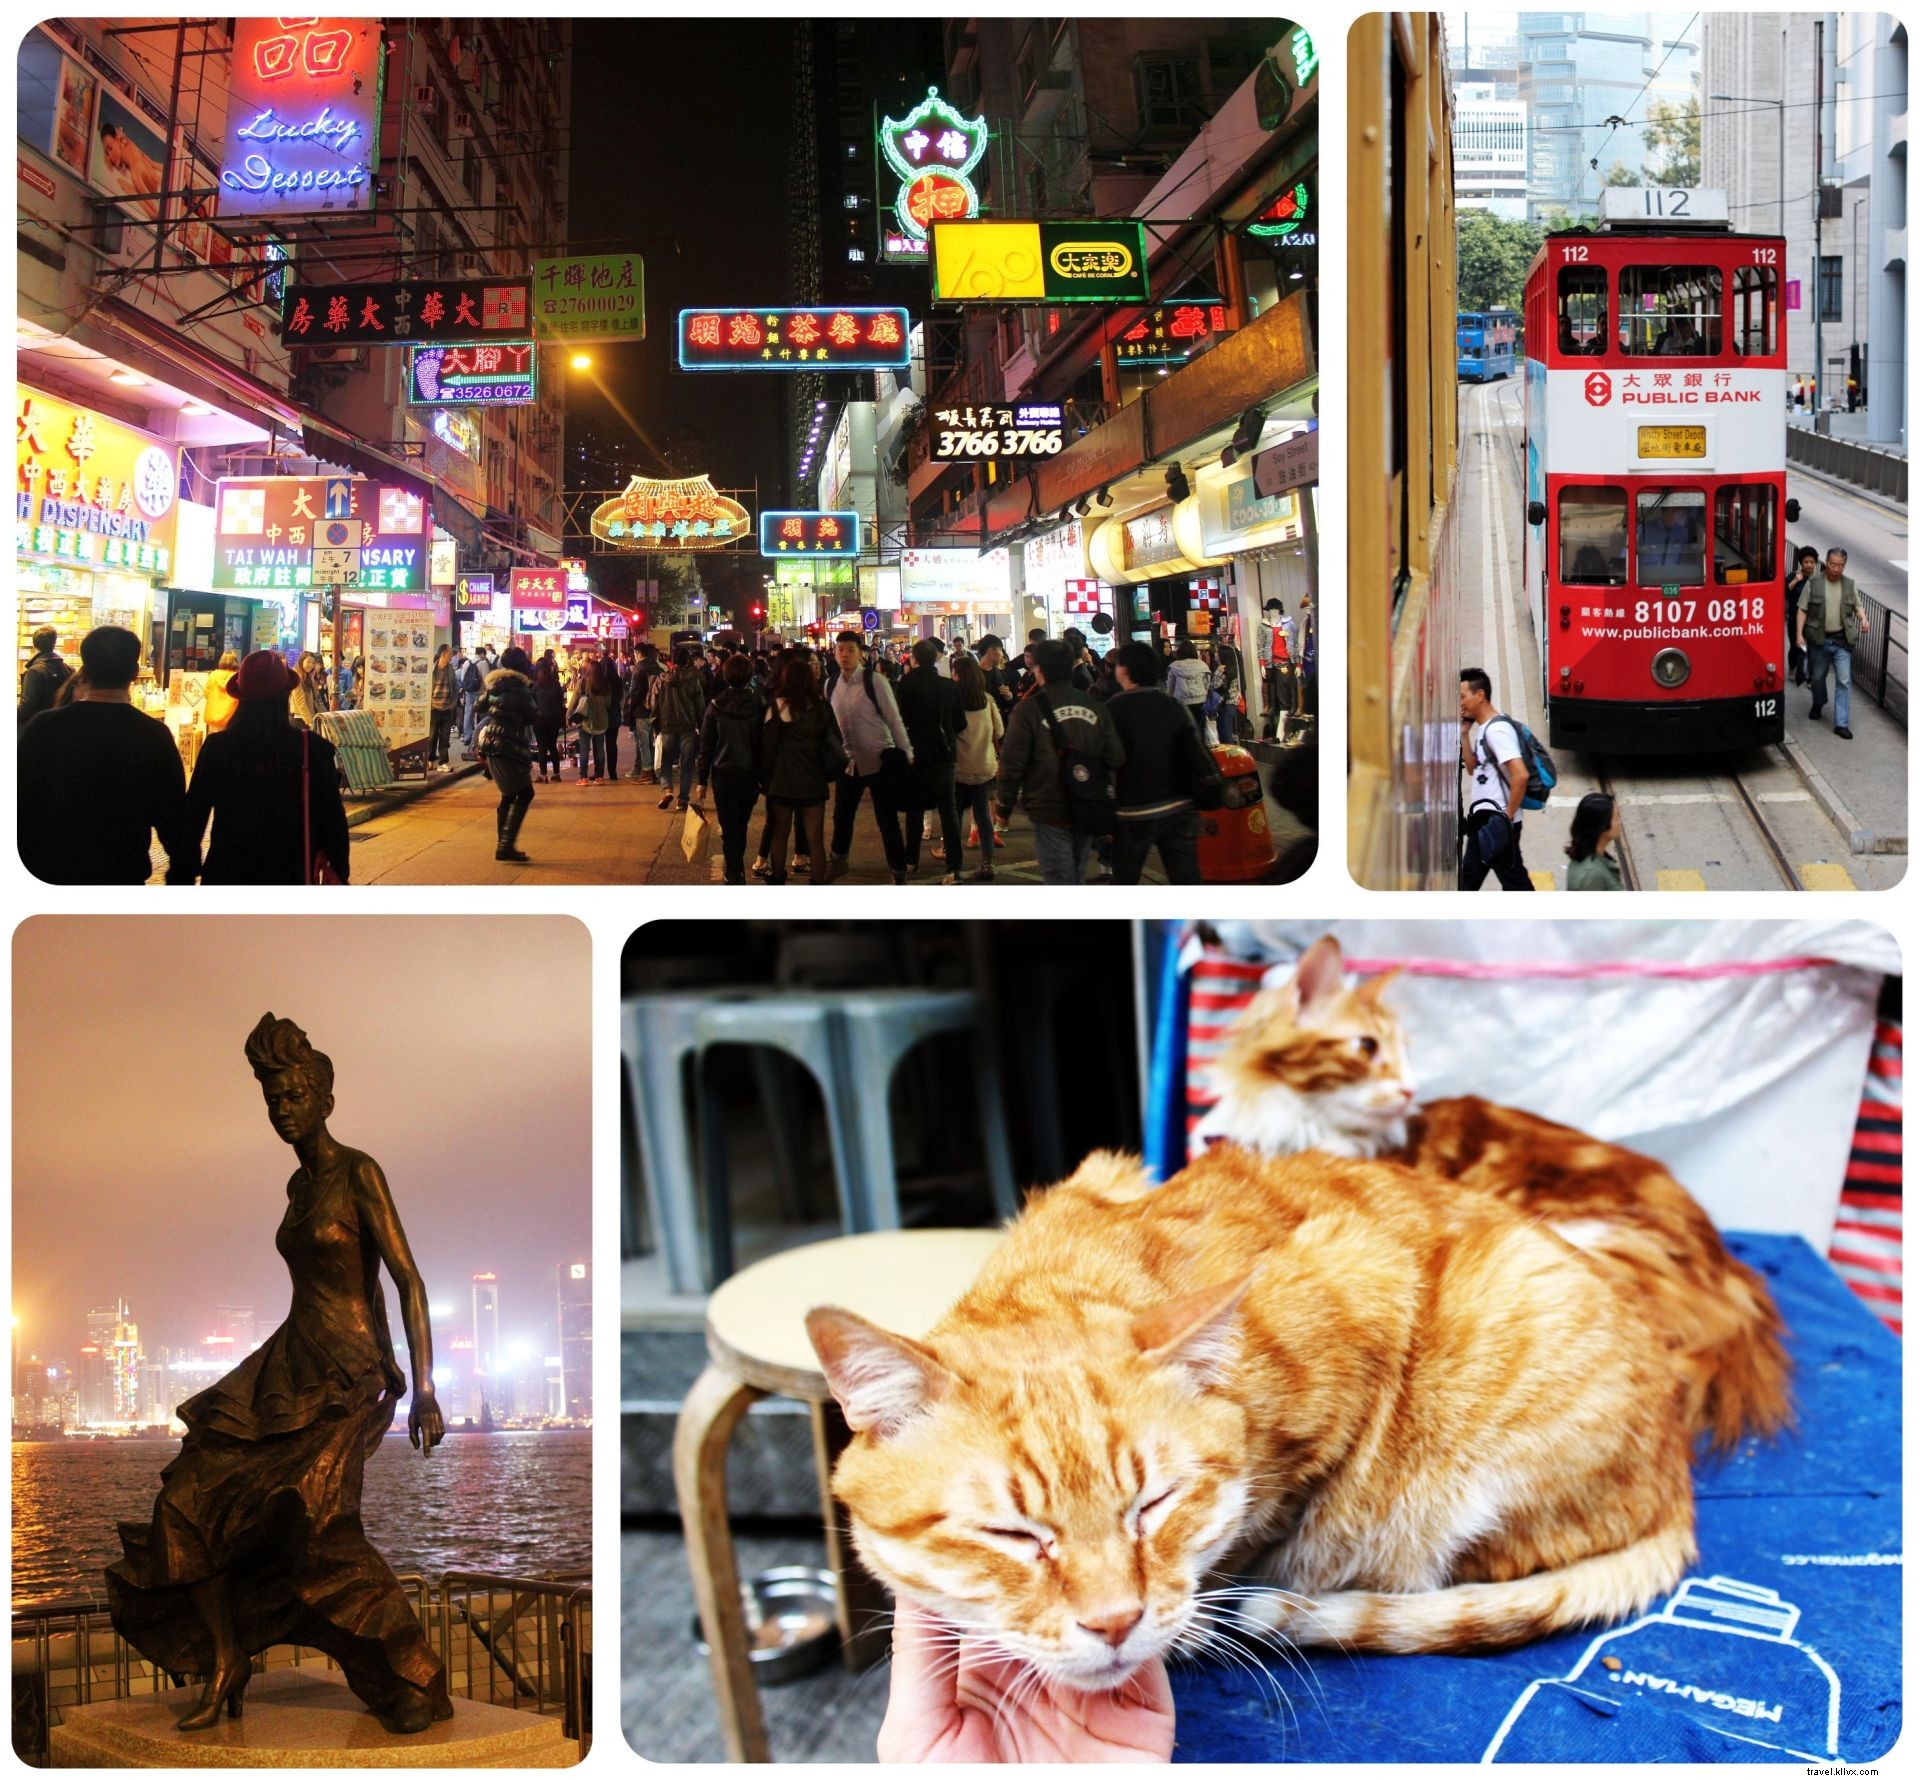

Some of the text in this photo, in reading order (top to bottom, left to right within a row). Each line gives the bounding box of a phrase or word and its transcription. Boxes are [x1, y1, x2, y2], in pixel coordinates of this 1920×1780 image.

[238, 108, 359, 149] Lucky
[222, 154, 365, 190] Dessert
[1645, 190, 1690, 217] 112
[1562, 246, 1589, 262] 112
[1752, 248, 1777, 264] 112
[559, 294, 635, 315] 27600029
[455, 385, 531, 399] 3526 0672
[1622, 390, 1761, 404] PUBLIC BANK
[937, 429, 1063, 456] 3766 3766
[1663, 429, 1683, 440] Street
[1684, 429, 1704, 441] Depot
[40, 498, 150, 543] DISPENSARY
[226, 550, 250, 566] TAI
[261, 550, 299, 566] WAH
[343, 551, 352, 564] 7
[343, 571, 357, 583] 12
[1635, 601, 1697, 623] 8107
[1707, 597, 1765, 622] 0818
[1582, 623, 1764, 640] www.publicbank.com.hk
[1754, 700, 1776, 717] 112
